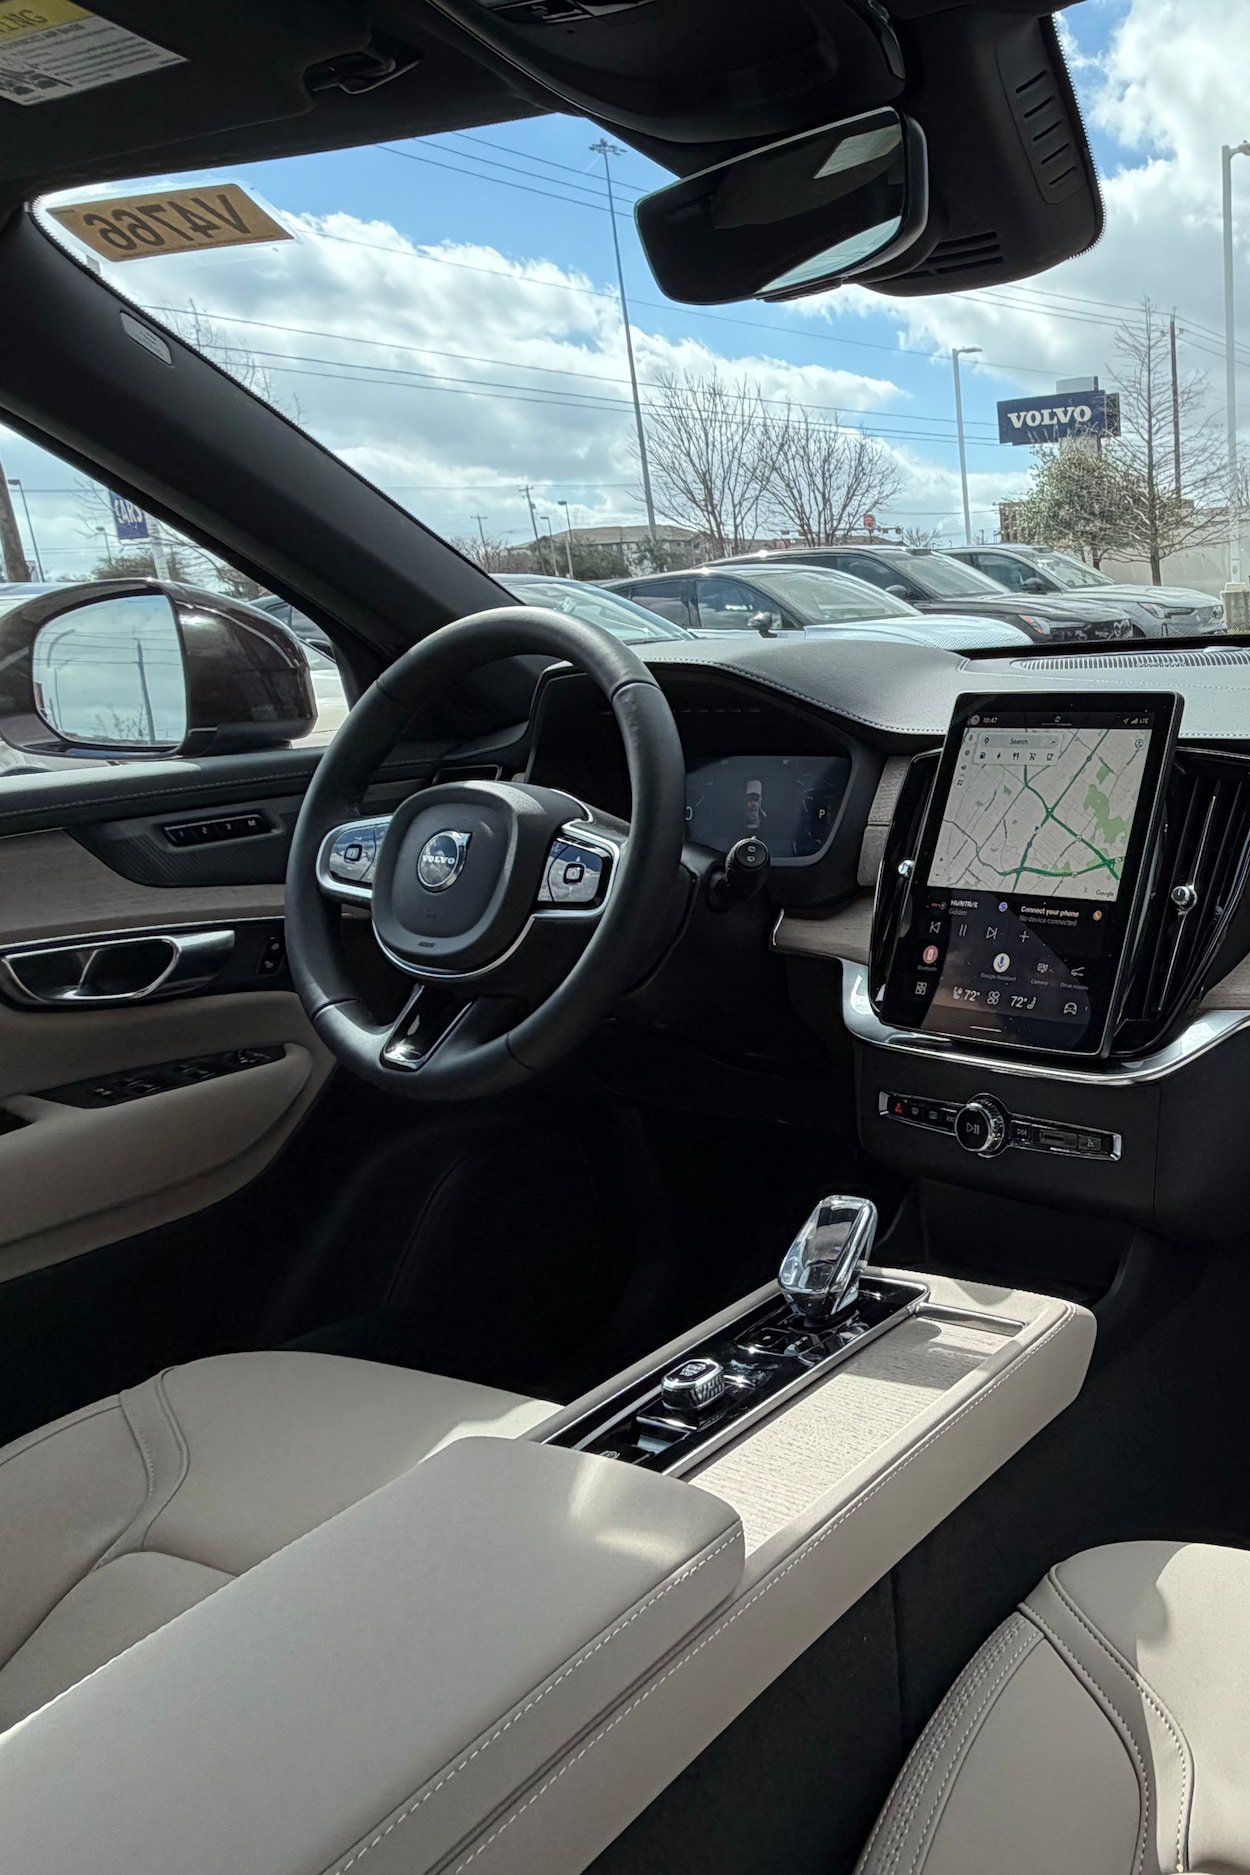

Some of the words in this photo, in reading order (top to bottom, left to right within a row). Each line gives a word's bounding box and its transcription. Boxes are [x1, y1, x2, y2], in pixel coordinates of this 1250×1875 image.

[1007, 405, 1092, 428] VOLVO
[819, 809, 825, 819] P
[422, 855, 456, 865] VOLVO
[1021, 906, 1046, 915] Connect
[1046, 908, 1060, 917] your
[1060, 909, 1079, 918] phone
[1048, 918, 1077, 926] connected
